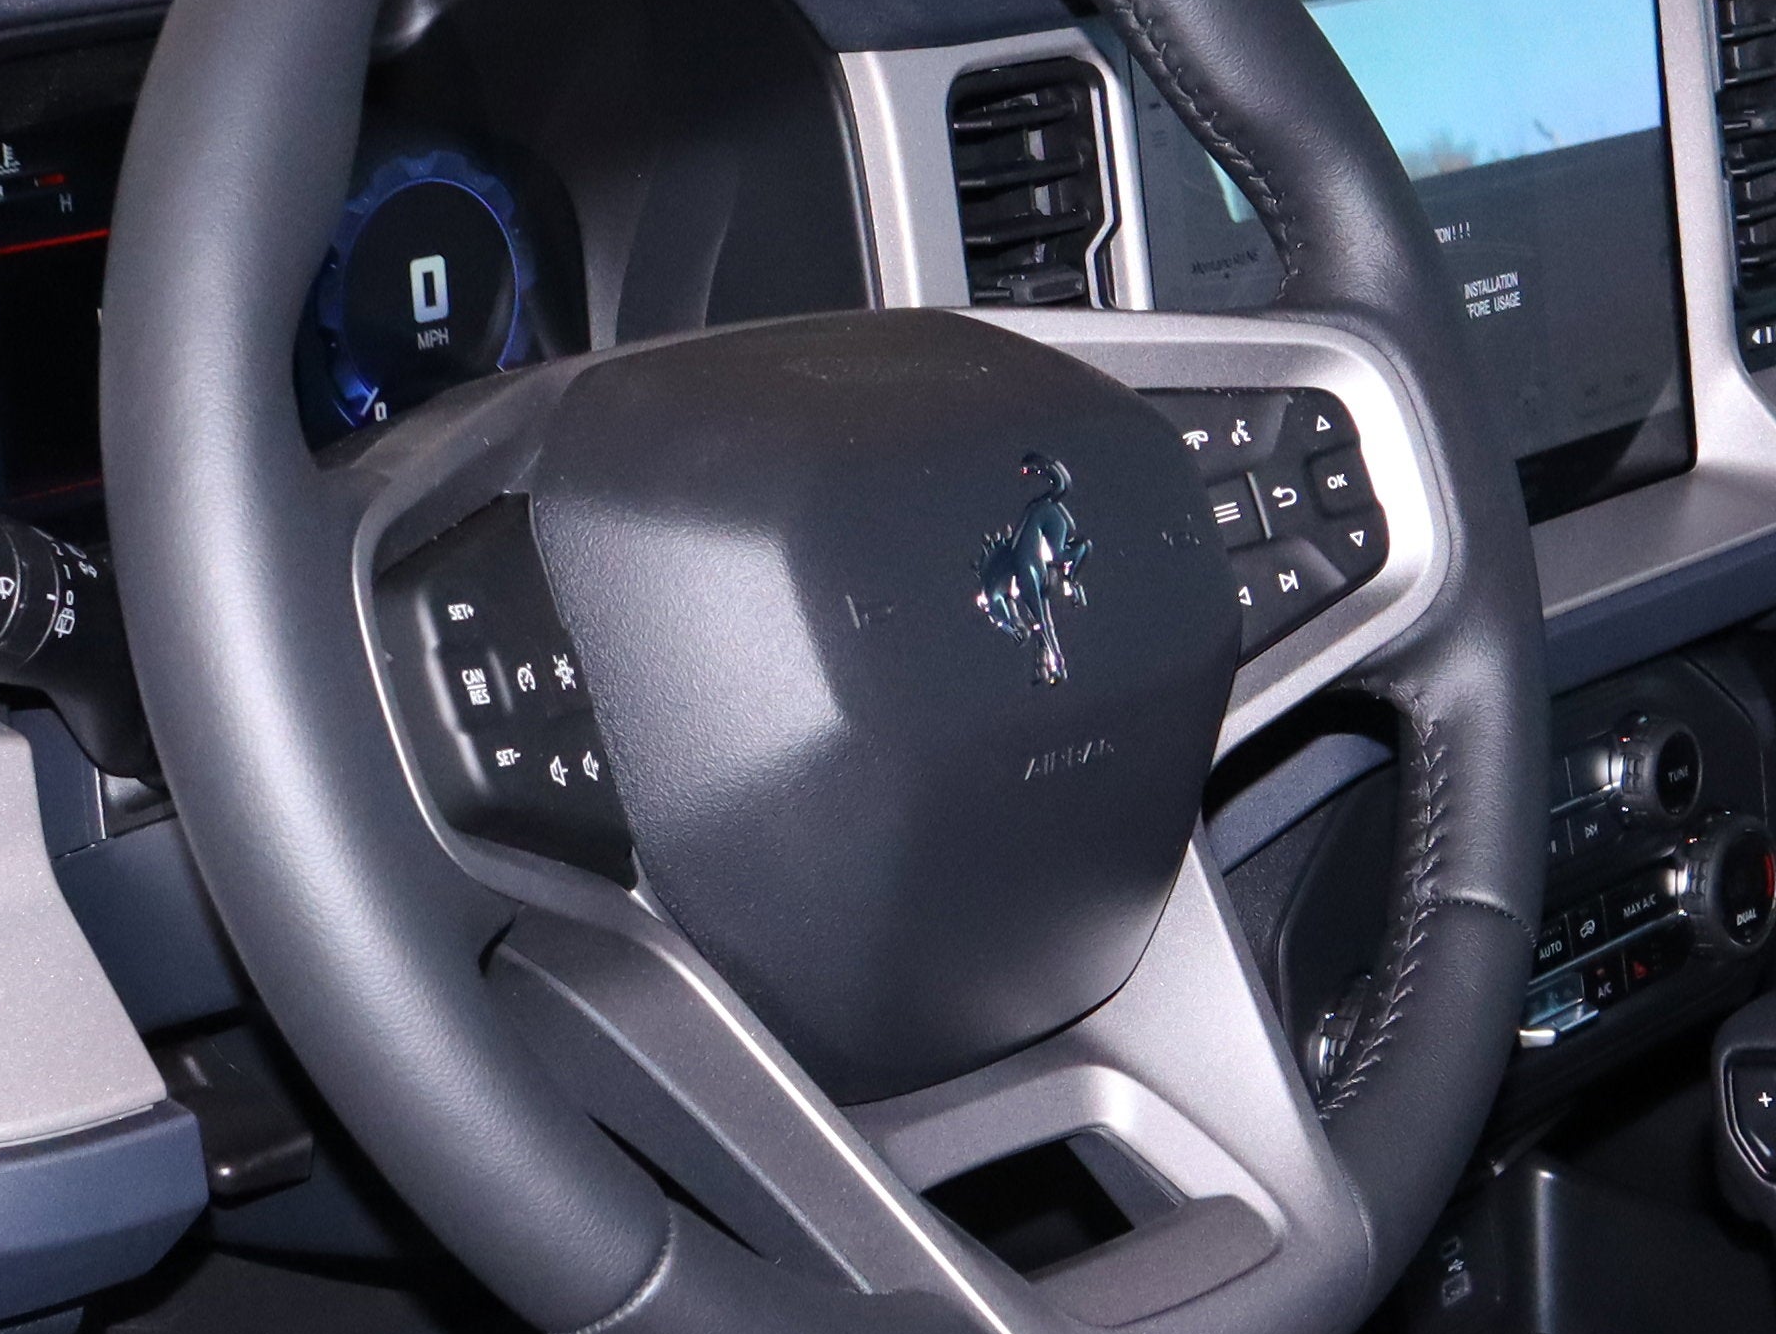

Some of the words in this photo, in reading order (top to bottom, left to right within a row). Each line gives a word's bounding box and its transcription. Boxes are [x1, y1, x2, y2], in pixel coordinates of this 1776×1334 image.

[409, 253, 450, 324] 0
[1463, 270, 1520, 300] INSTALLATION
[416, 327, 450, 351] MPH
[1326, 472, 1349, 490] OK
[461, 668, 486, 685] CAN
[469, 688, 491, 706] RES
[1735, 906, 1758, 927] DUAL
[1538, 939, 1563, 961] AUTO
[1596, 981, 1613, 1000] A/C
